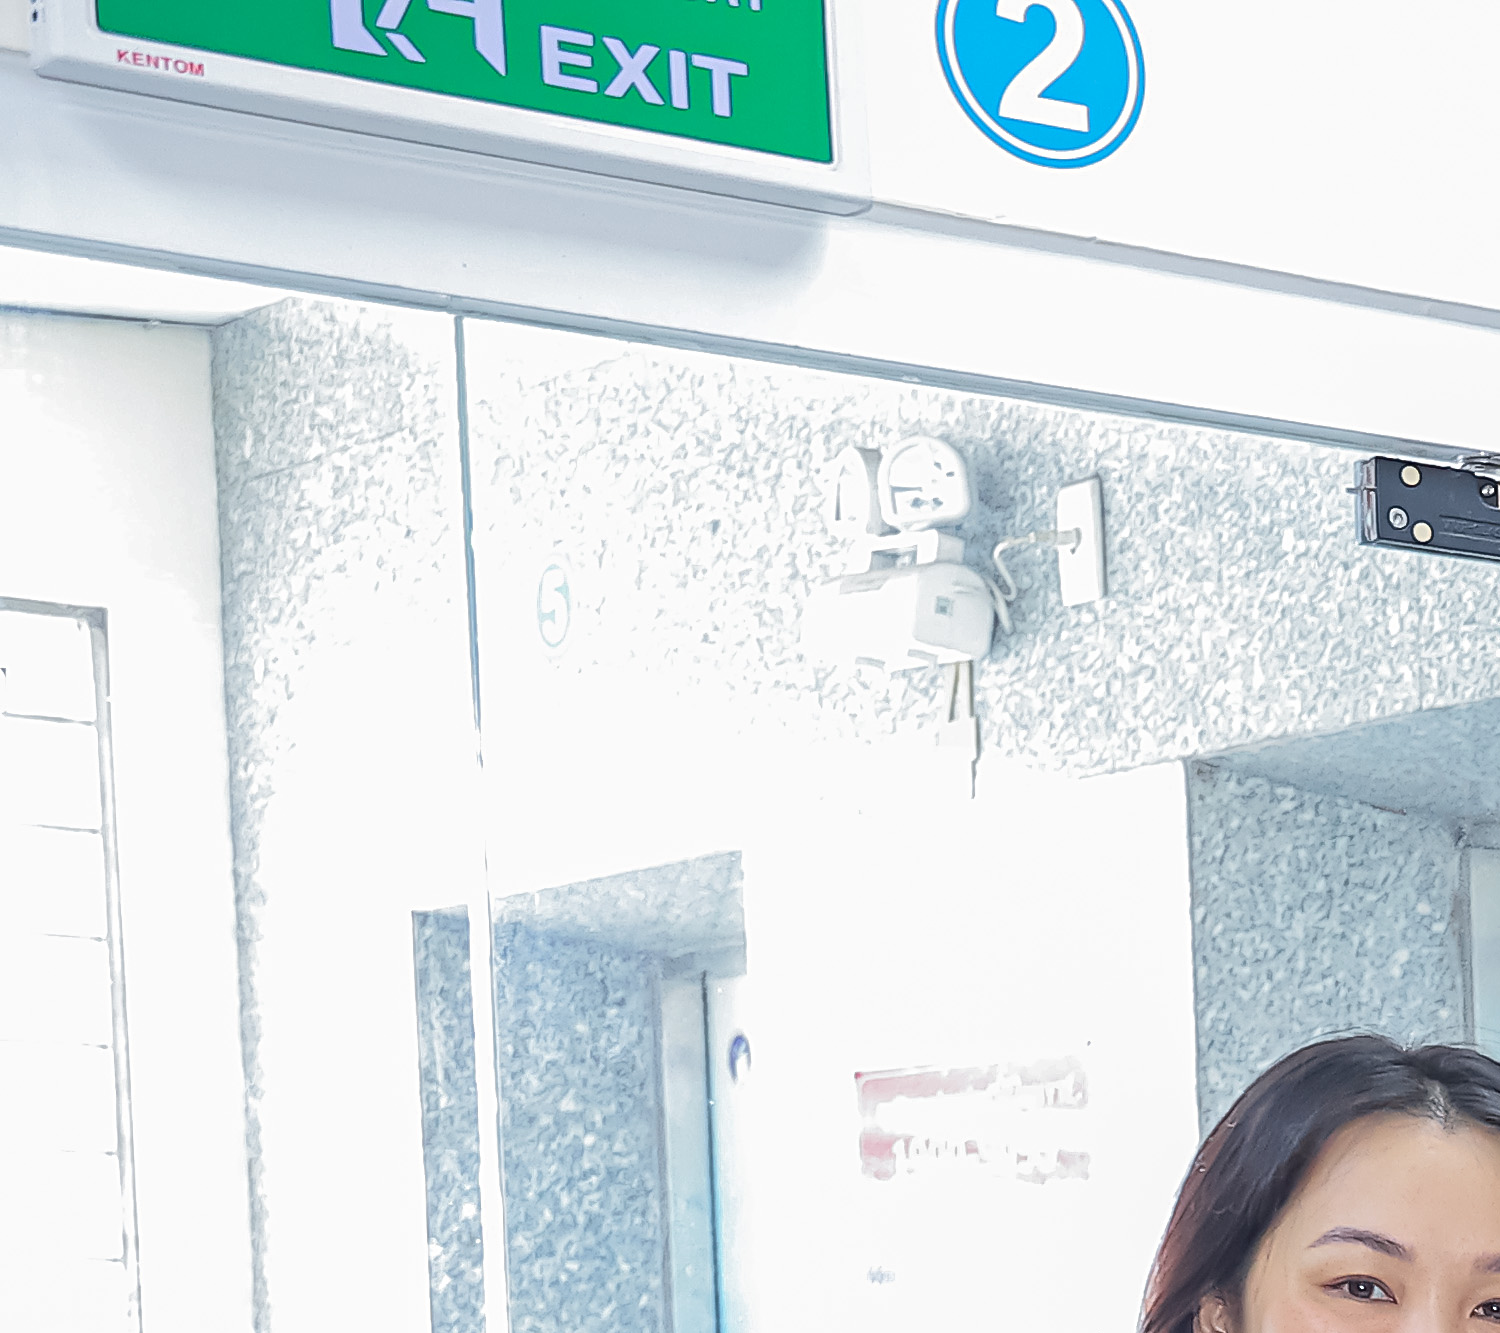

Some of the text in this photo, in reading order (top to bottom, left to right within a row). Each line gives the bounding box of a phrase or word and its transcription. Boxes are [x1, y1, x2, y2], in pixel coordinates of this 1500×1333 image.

[115, 47, 206, 78] KENTOM
[539, 24, 749, 118] EXIT
[996, 0, 1093, 133] 2
